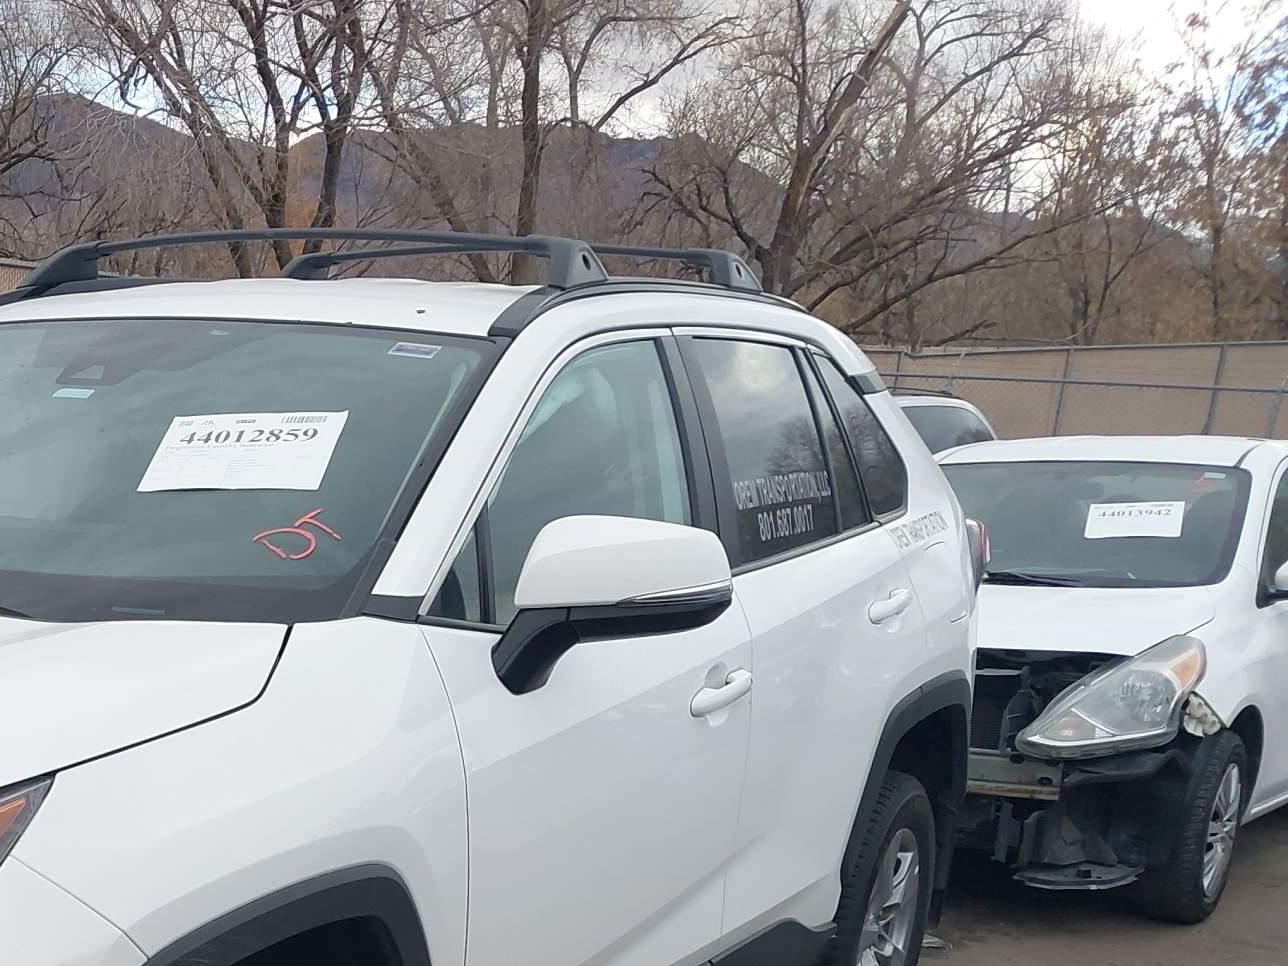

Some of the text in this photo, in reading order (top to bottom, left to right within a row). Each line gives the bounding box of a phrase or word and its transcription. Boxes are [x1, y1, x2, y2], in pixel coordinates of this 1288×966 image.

[179, 428, 319, 444] 44012859
[1098, 508, 1171, 517] 44013942
[757, 504, 814, 541] 801.687.0017
